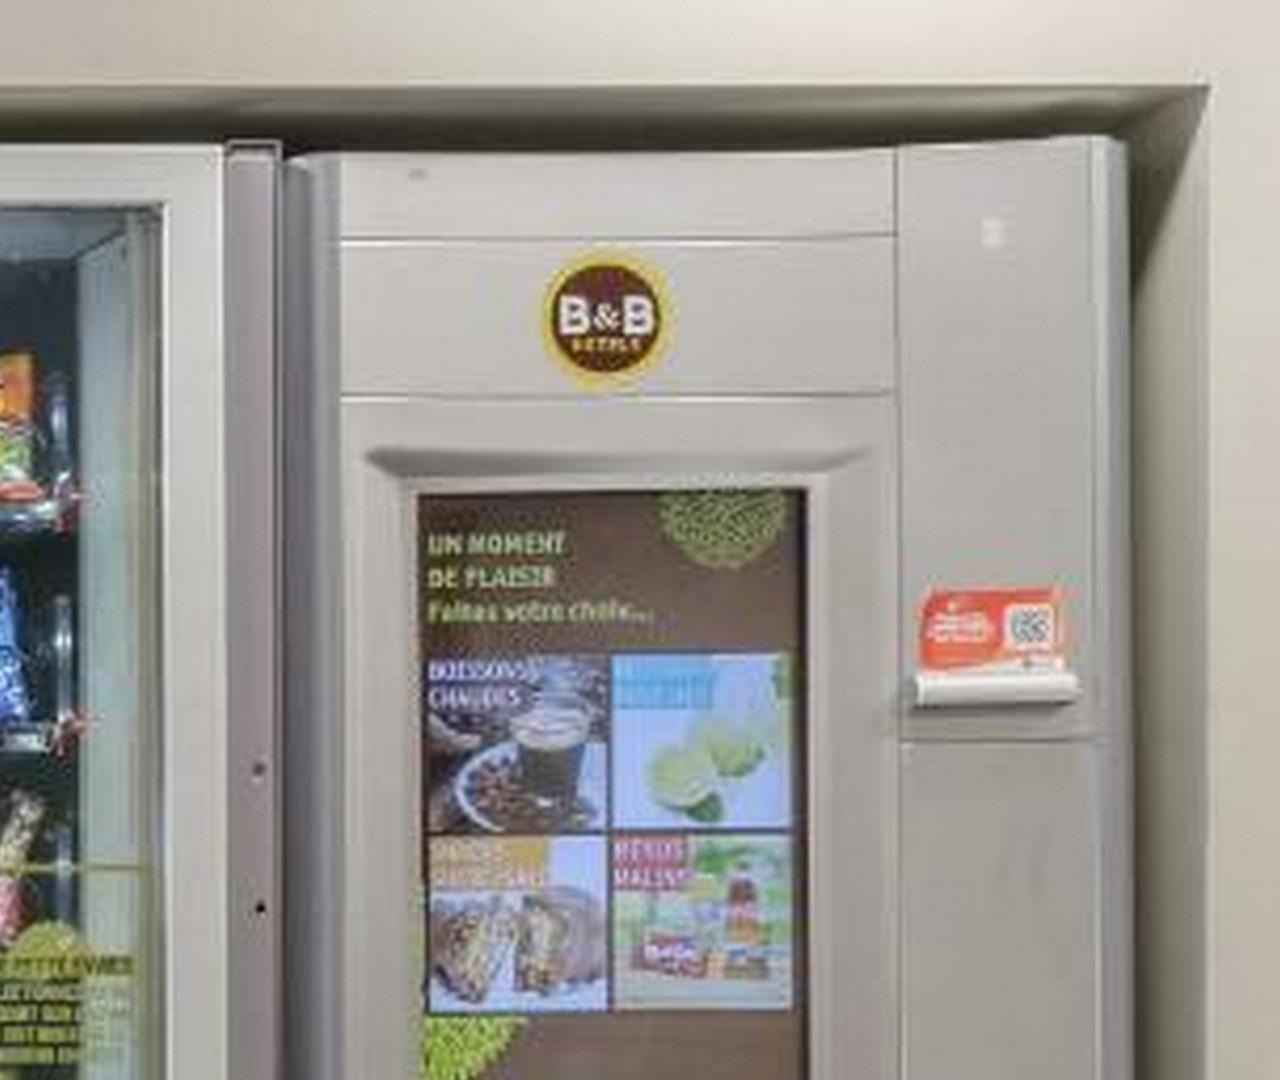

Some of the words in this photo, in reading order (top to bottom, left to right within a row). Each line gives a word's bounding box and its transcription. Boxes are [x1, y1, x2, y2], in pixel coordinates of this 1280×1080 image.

[559, 294, 654, 336] B&B
[428, 533, 461, 555] UN
[467, 531, 565, 554] MOMENT
[428, 568, 459, 588] DE
[465, 566, 555, 588] PLAISIR
[505, 602, 565, 622] votre
